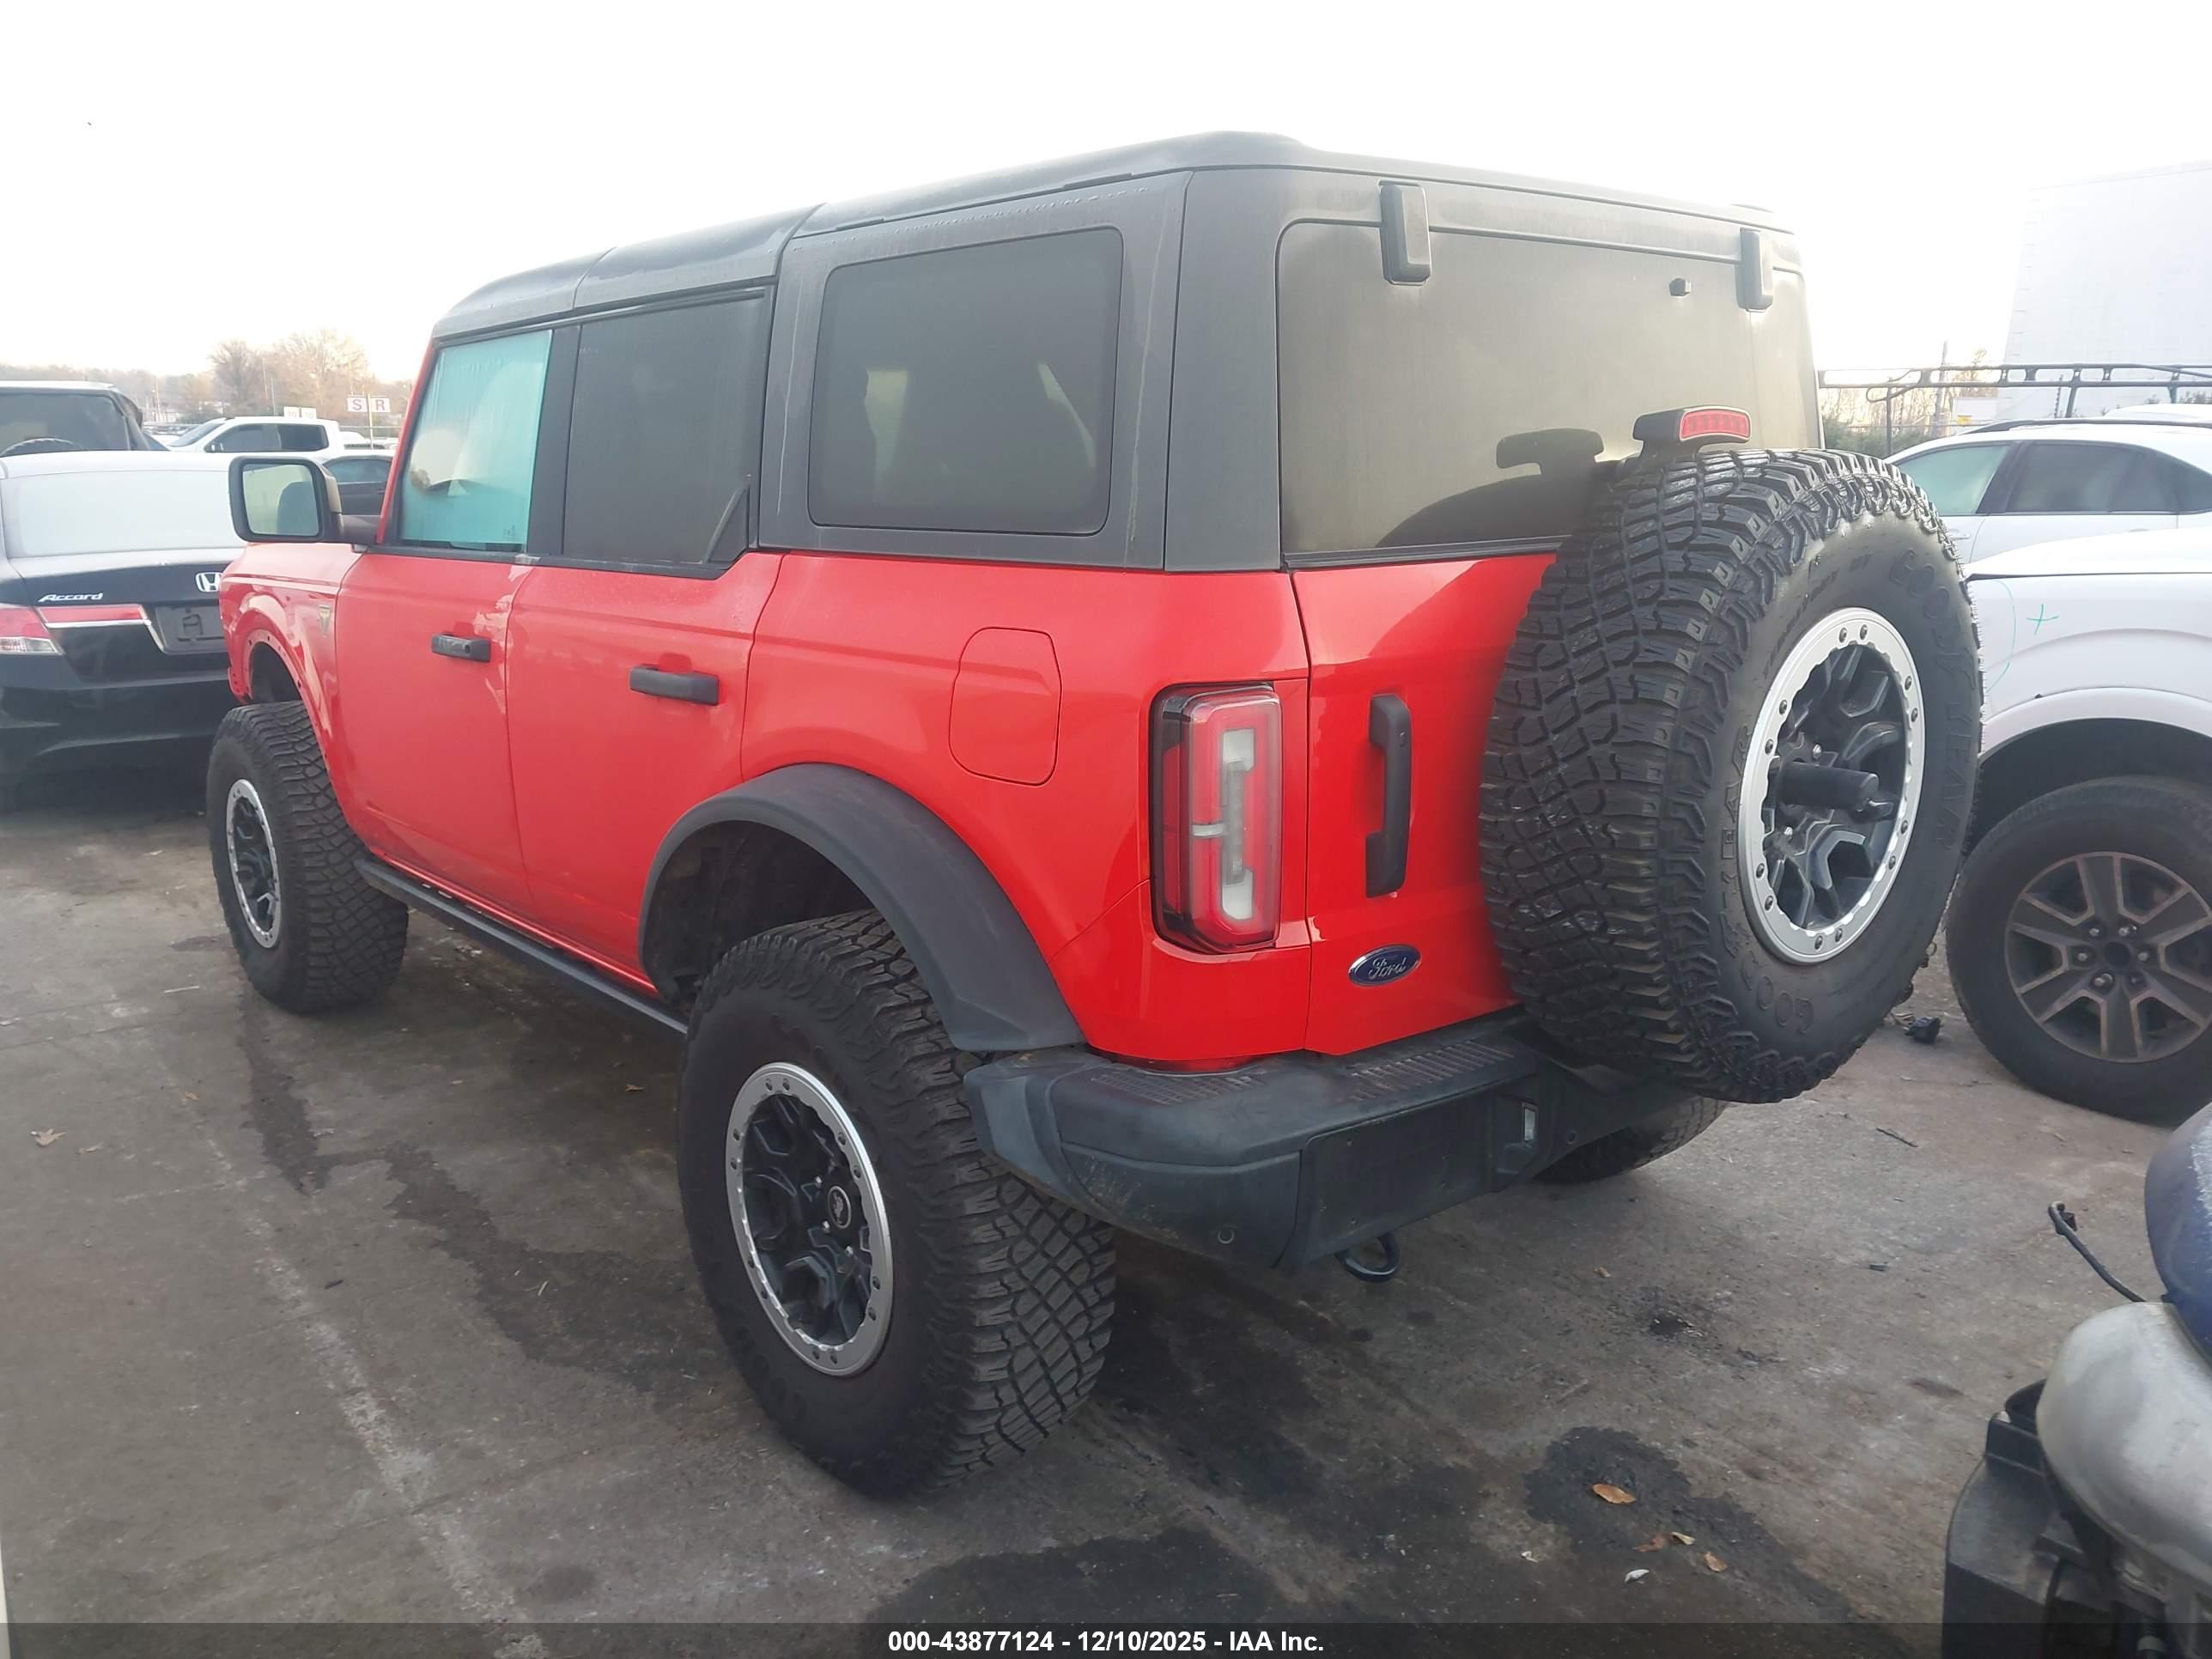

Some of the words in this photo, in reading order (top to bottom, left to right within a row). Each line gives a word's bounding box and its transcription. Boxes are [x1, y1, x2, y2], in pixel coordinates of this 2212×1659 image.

[352, 398, 362, 410] S
[375, 398, 386, 410] R
[39, 592, 103, 602] Accord
[1368, 957, 1407, 980] Ford
